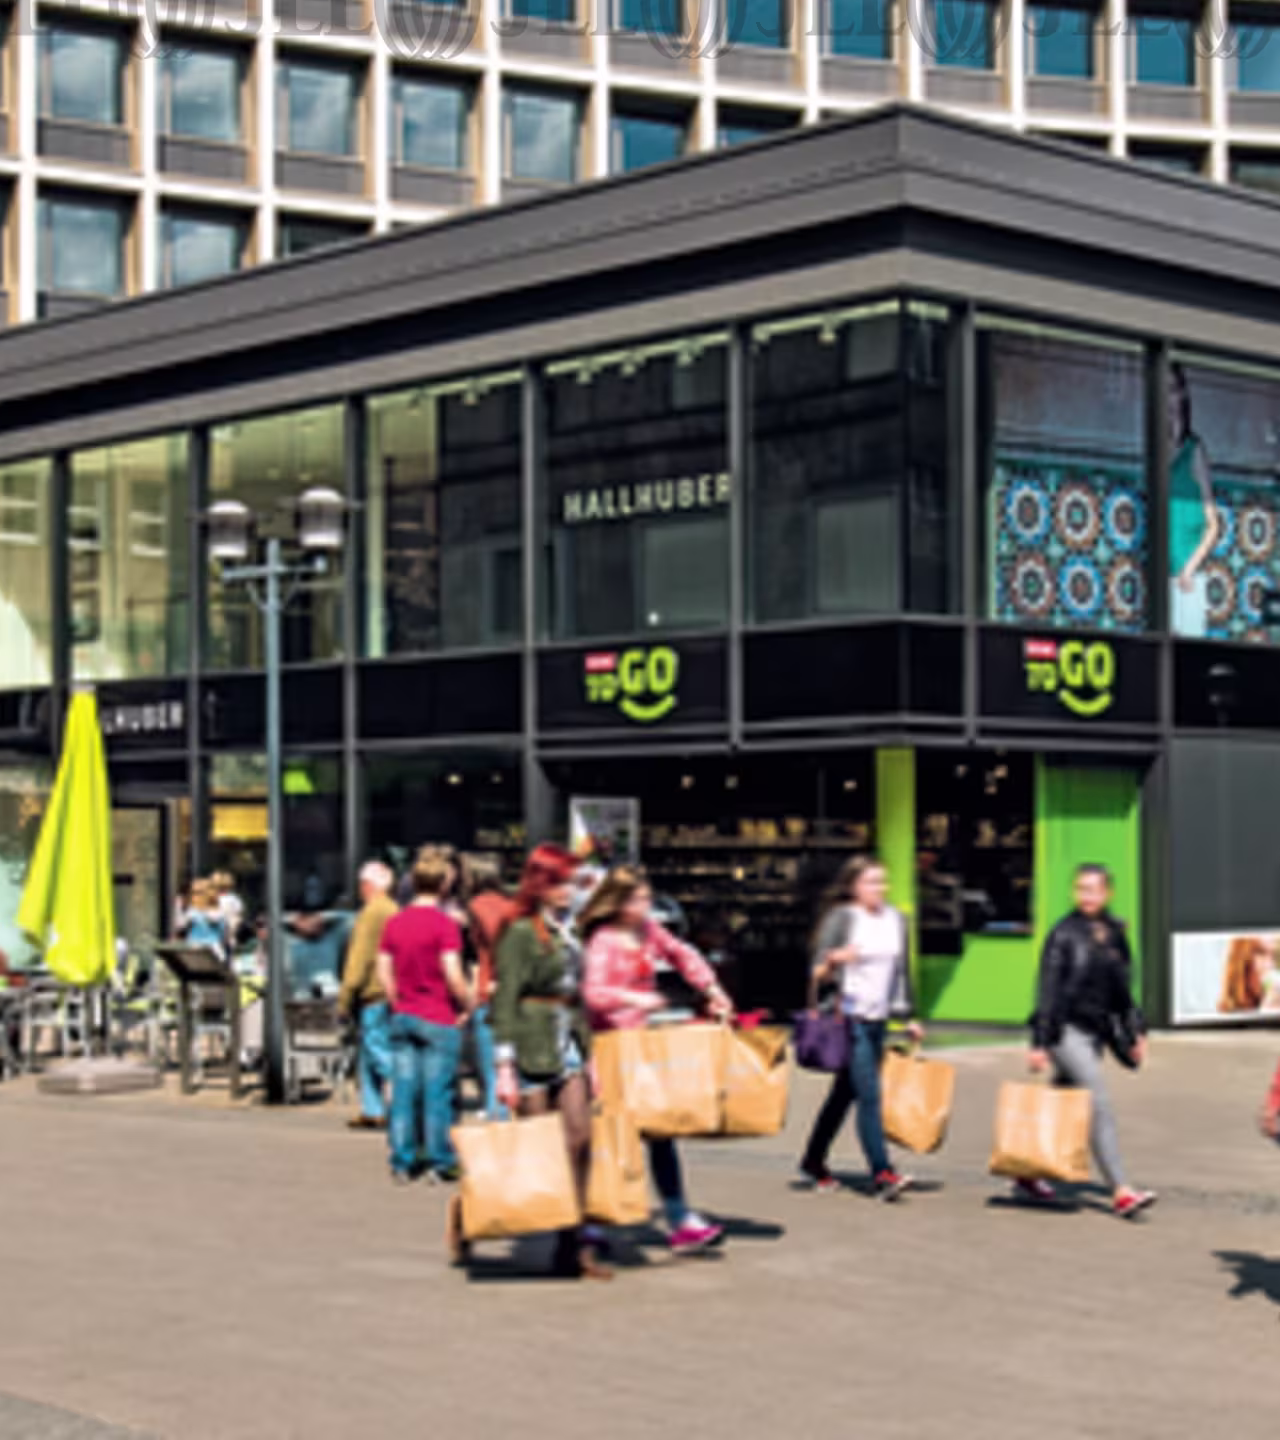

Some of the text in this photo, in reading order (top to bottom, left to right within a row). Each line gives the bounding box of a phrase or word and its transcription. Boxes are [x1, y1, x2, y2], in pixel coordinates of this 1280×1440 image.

[564, 473, 731, 523] HALLHUBER
[621, 646, 677, 694] GO
[1060, 640, 1114, 688] GO
